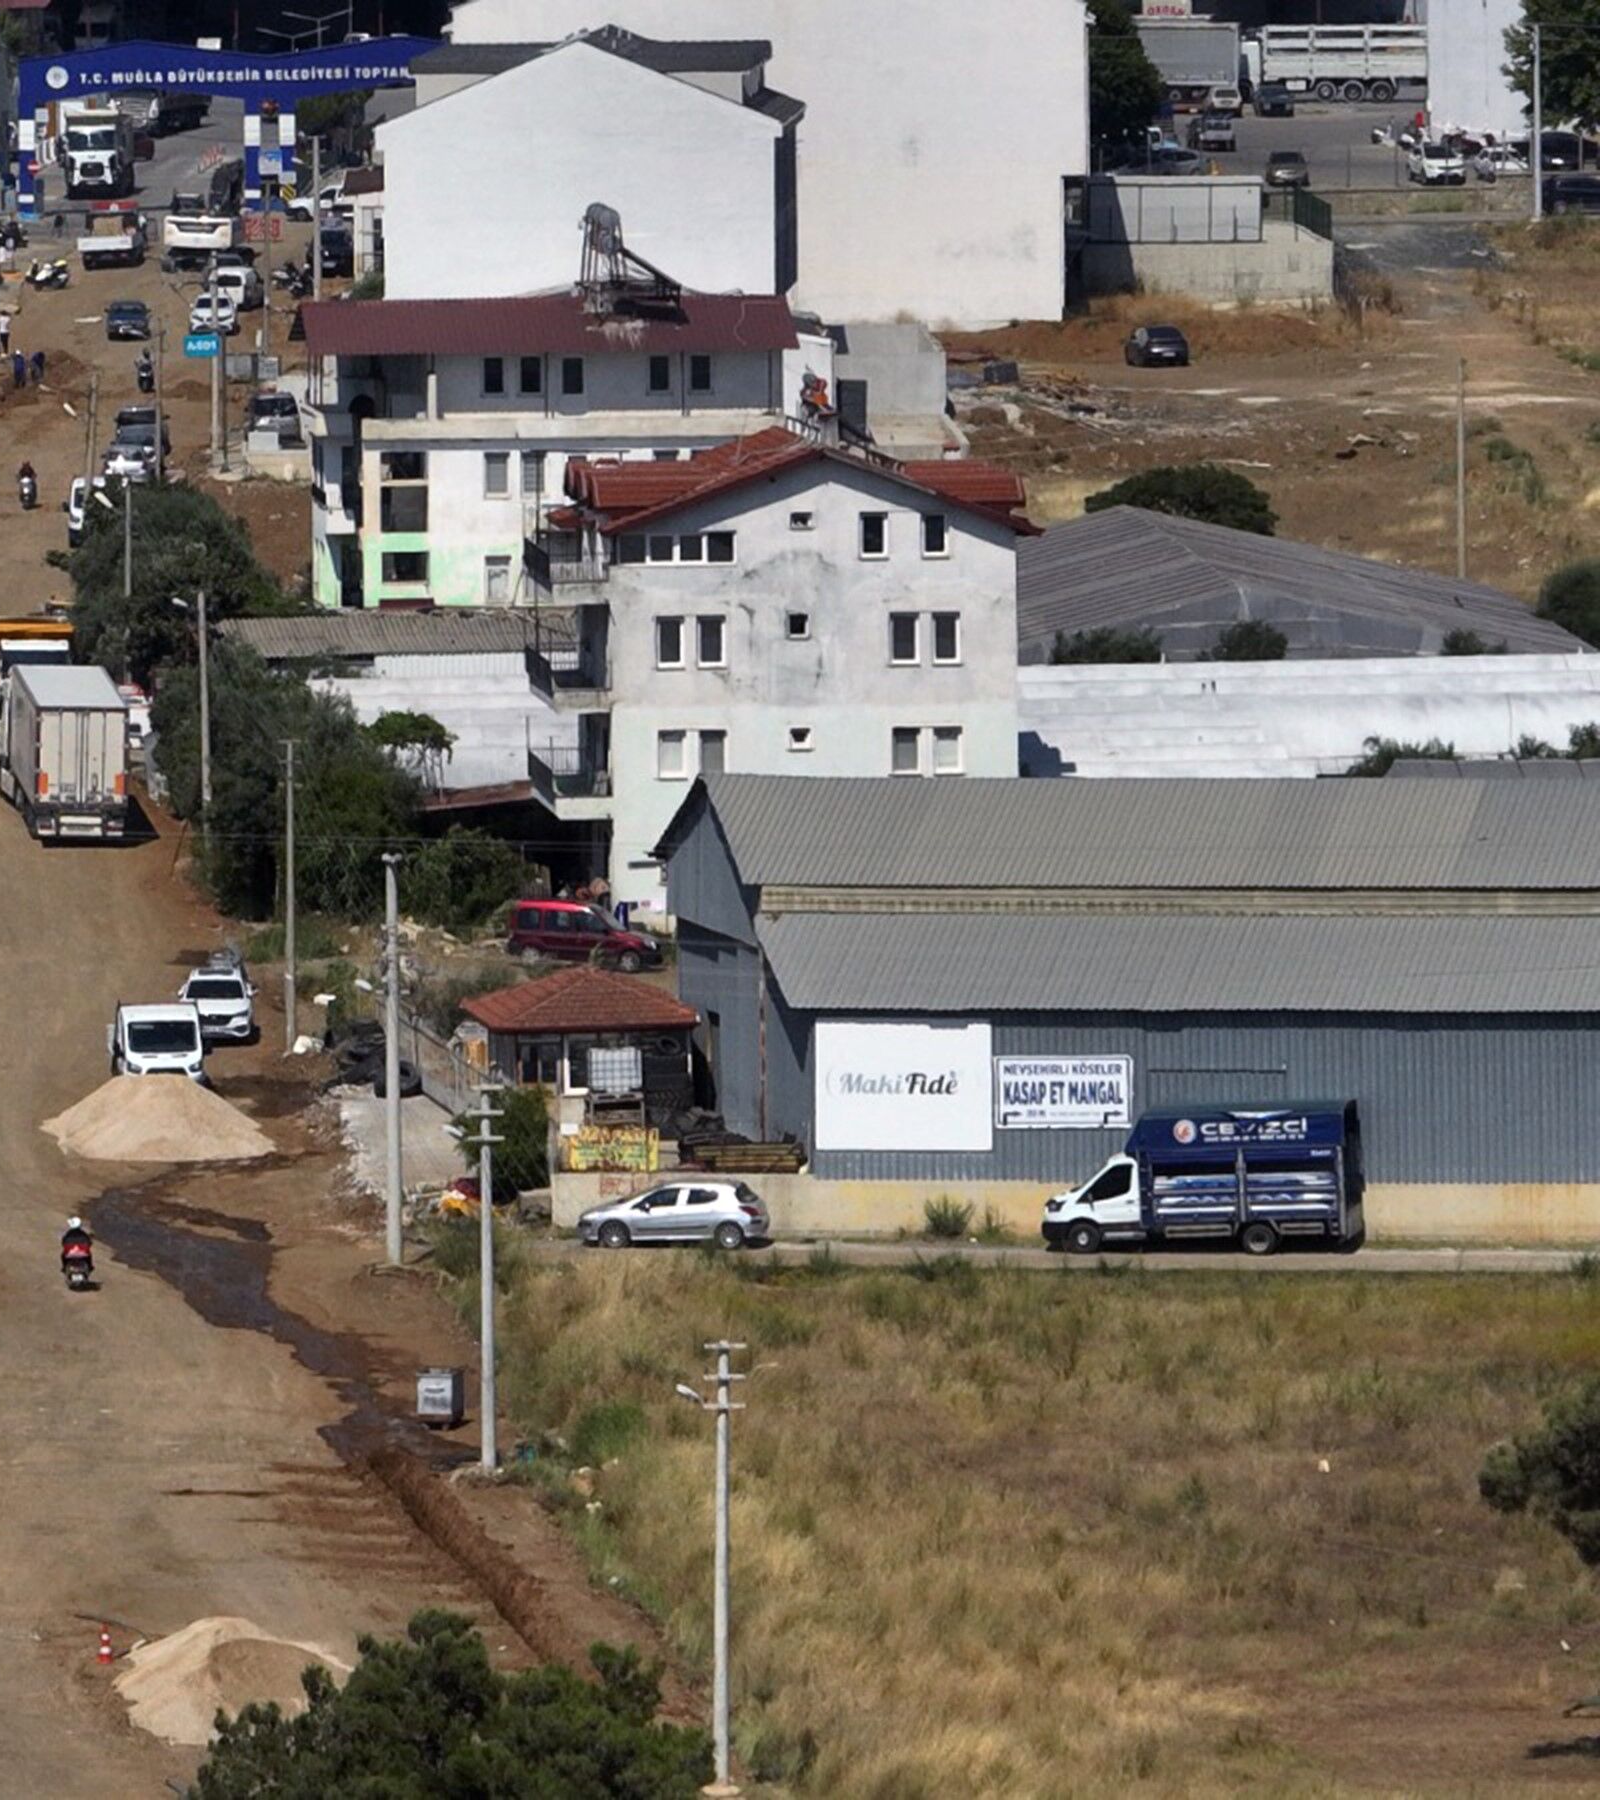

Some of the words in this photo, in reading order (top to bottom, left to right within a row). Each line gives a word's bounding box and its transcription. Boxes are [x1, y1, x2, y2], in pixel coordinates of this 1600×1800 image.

[79, 72, 108, 85] T.C.
[111, 68, 164, 84] MUĞLA
[167, 67, 261, 84] BÜYÜKŞEHİR
[264, 65, 350, 81] BELEDİYESİ
[1003, 1081, 1047, 1105] KASAP
[1050, 1081, 1065, 1104] ET
[1068, 1081, 1124, 1104] MANGAL
